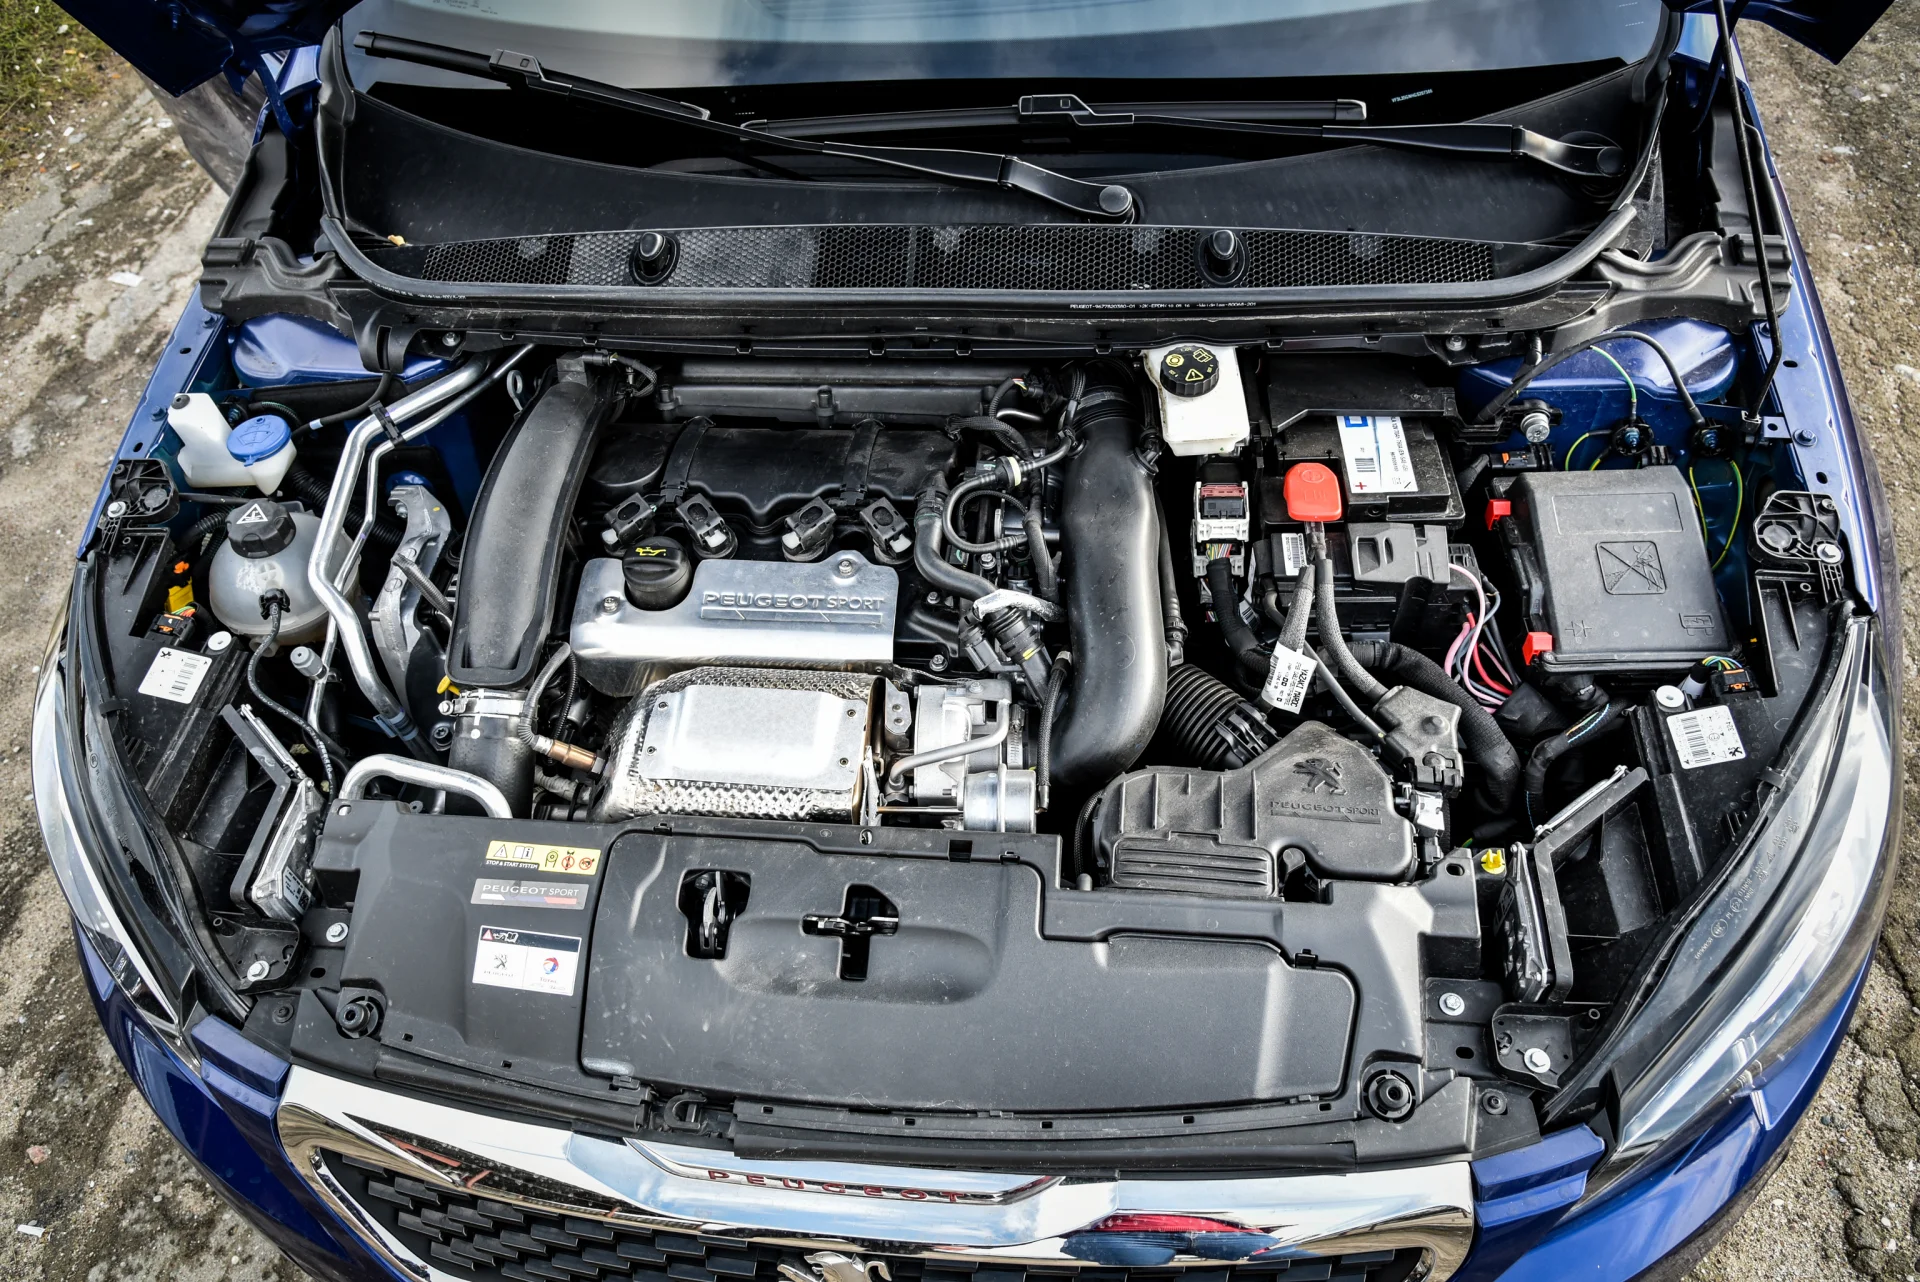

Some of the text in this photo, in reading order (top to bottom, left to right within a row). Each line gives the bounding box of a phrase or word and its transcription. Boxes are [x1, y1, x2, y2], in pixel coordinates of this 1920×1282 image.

[702, 590, 885, 610] PEUGEOT SPORT
[1295, 668, 1309, 689] YAZAKI
[1290, 691, 1302, 708] MAROC
[1270, 801, 1380, 816] PEUGEOT SPORT
[482, 884, 580, 897] PEUGEOT SPORT
[707, 1170, 965, 1203] PEUGEOT
